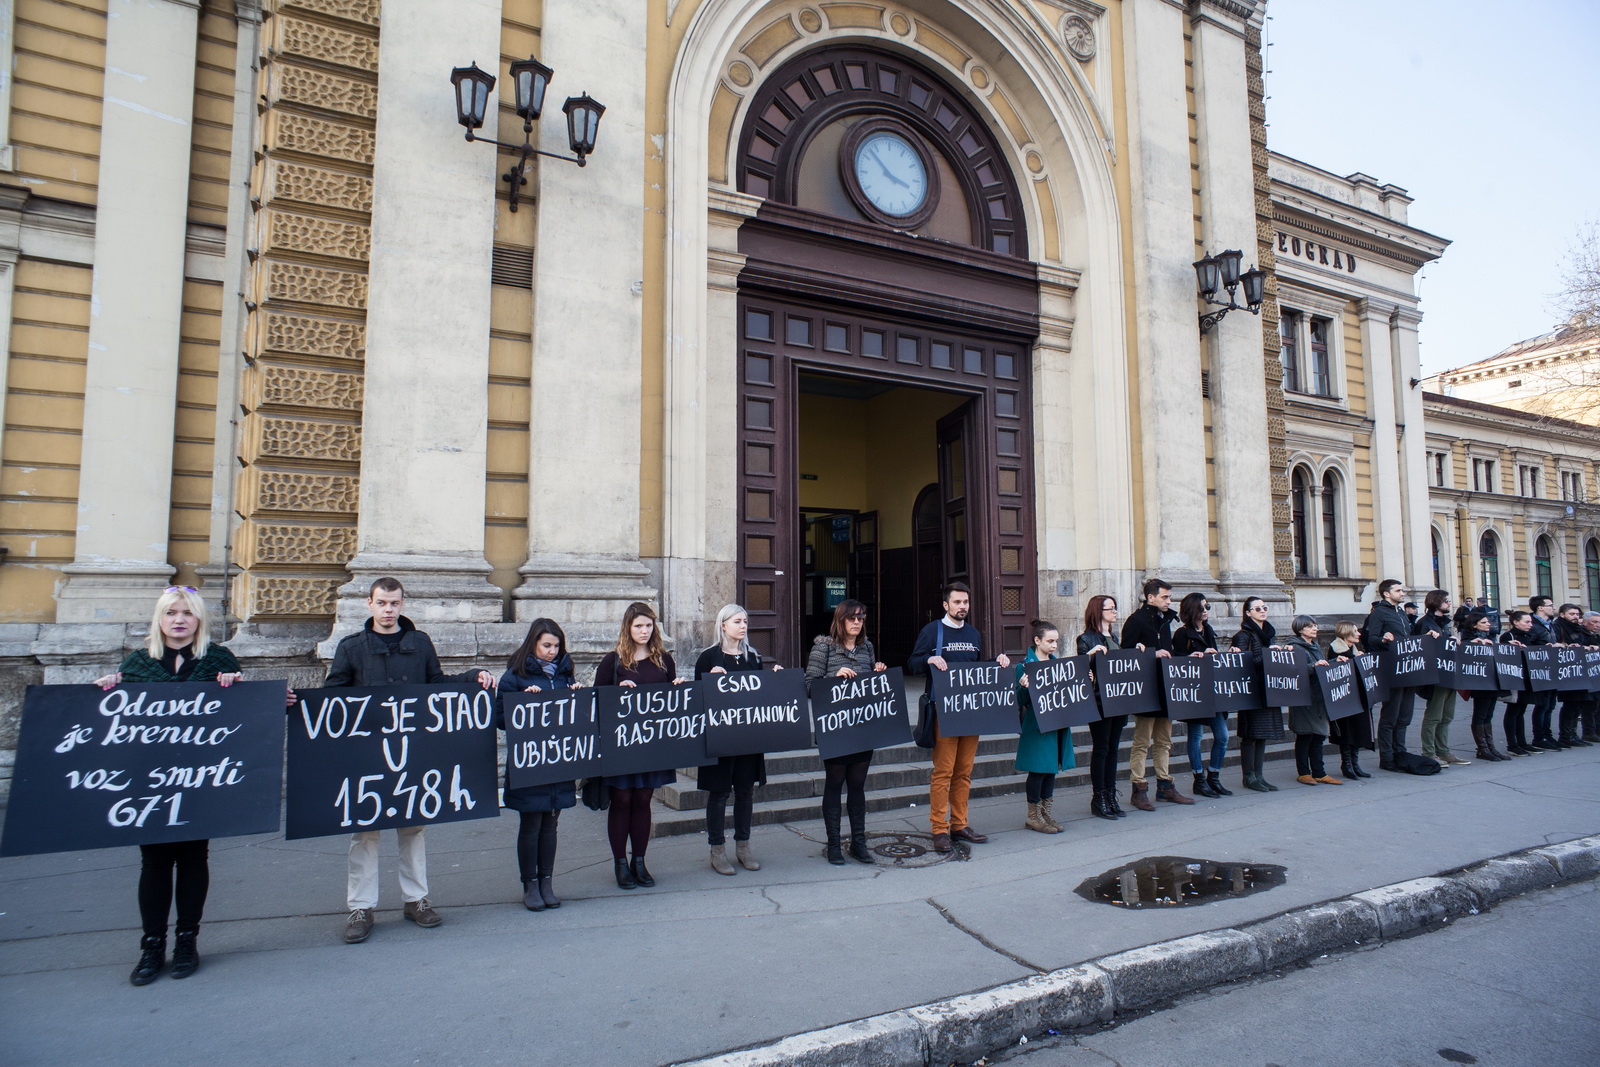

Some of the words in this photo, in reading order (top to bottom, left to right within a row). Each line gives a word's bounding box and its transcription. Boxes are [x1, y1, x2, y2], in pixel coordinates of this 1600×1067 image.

[1277, 231, 1356, 273] EOGRAD
[1035, 660, 1076, 690] SENAD
[1108, 658, 1141, 675] TOMA
[1169, 661, 1201, 679] RASIM
[1212, 652, 1245, 668] SAFET
[717, 674, 762, 693] ESAD
[831, 674, 893, 703] DŽAFER
[949, 666, 1002, 688] FIKRET
[1105, 681, 1144, 698] BUZOV
[98, 689, 222, 717] Odavde
[511, 693, 576, 730] OTETI
[617, 688, 692, 718] JUSUF
[817, 693, 898, 733] TOPUZOVIĆ
[943, 683, 1015, 713] MEMETOVIĆ
[300, 695, 373, 739] VOZ
[425, 690, 492, 732] STAO
[54, 723, 93, 753] je
[100, 715, 243, 746] krenuo
[383, 735, 408, 772] U
[65, 768, 133, 791] voz
[148, 756, 246, 788] smrti
[108, 792, 190, 827] 671
